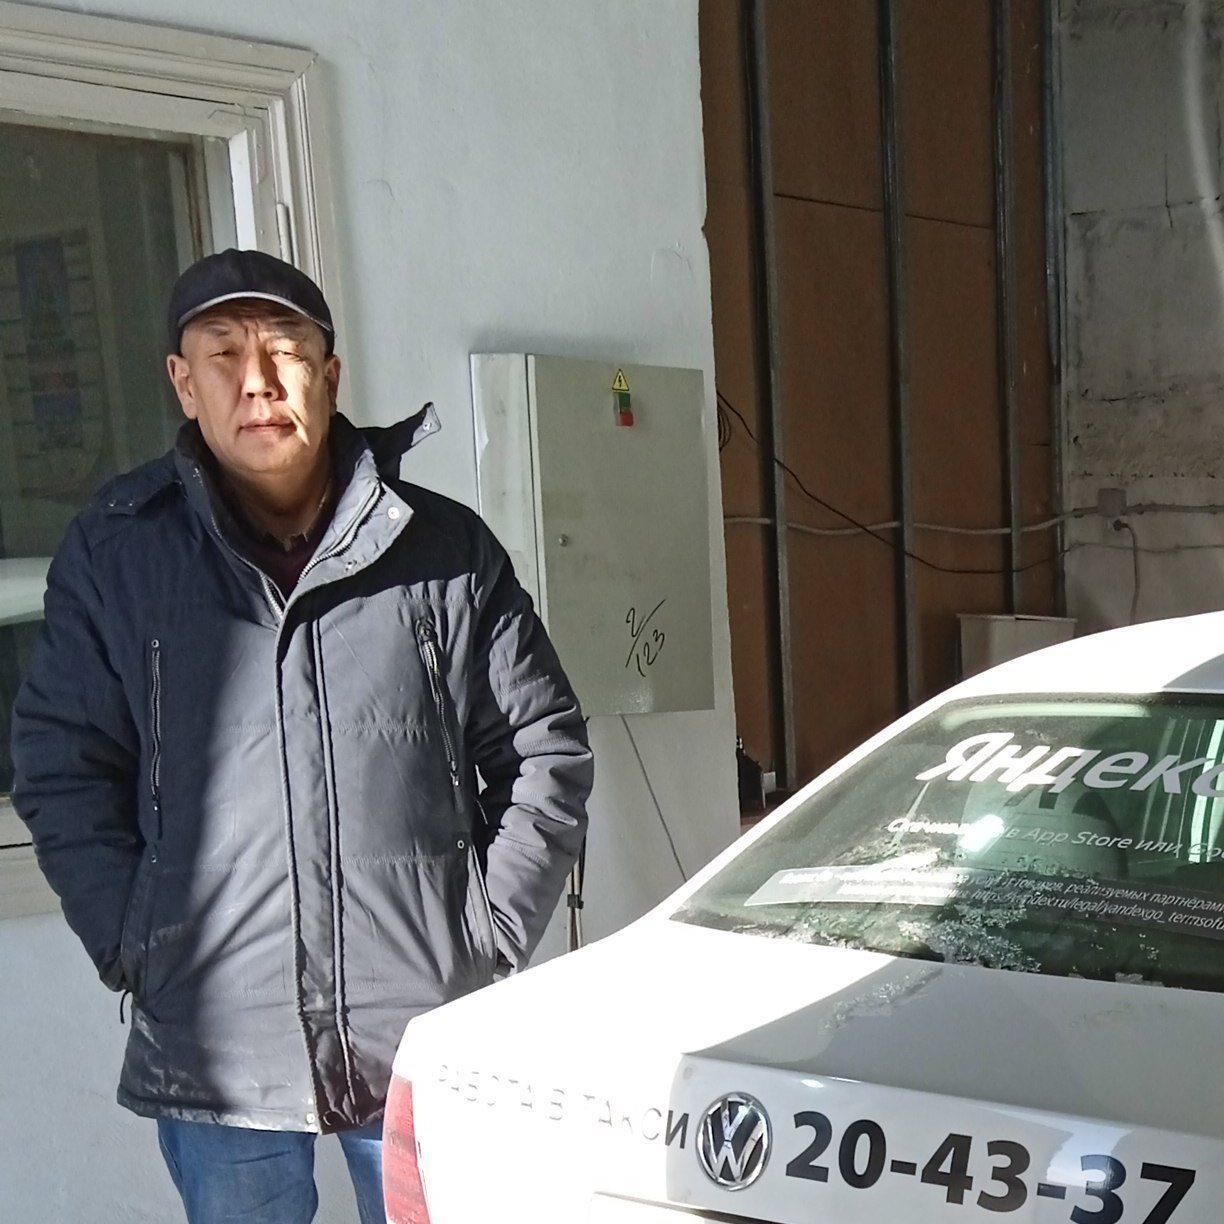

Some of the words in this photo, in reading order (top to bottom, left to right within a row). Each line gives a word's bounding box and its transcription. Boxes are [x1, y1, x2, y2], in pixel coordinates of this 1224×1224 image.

[1022, 827, 1069, 844] App
[1071, 831, 1133, 850] Store
[1134, 838, 1183, 854] или
